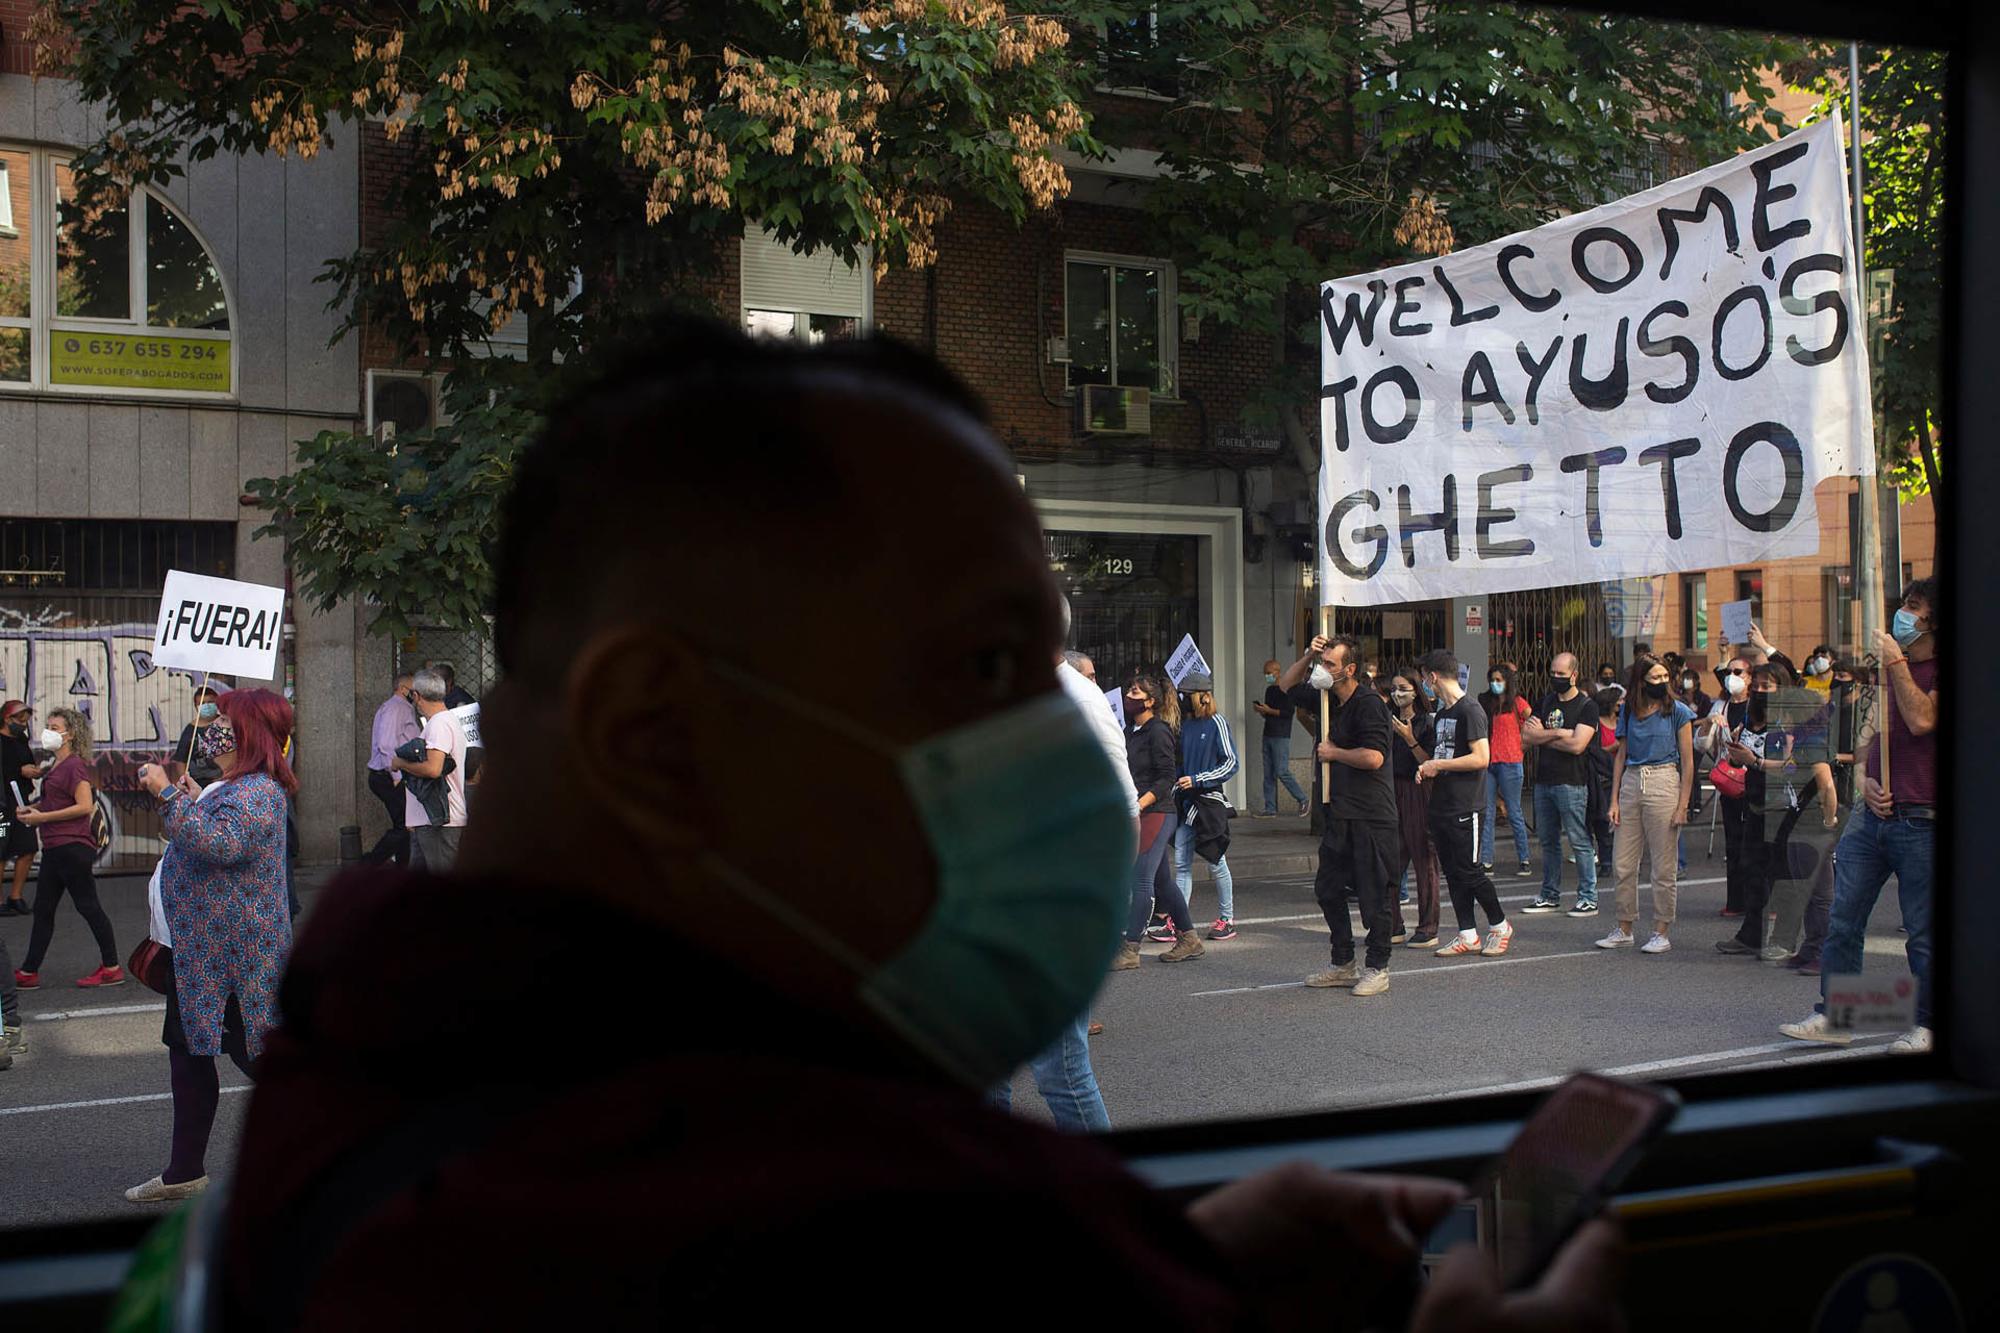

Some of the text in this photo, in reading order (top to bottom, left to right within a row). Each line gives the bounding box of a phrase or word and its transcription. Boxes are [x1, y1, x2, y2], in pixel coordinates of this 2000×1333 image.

[1322, 142, 1812, 356] WELCOME
[89, 340, 216, 361] 637 655 294
[1321, 364, 1421, 452] TO
[1461, 253, 1850, 433] AYUSO'S
[1324, 421, 1804, 581] GHETTO
[1104, 558, 1133, 574] 129
[161, 600, 279, 651] ¡FUERA!
